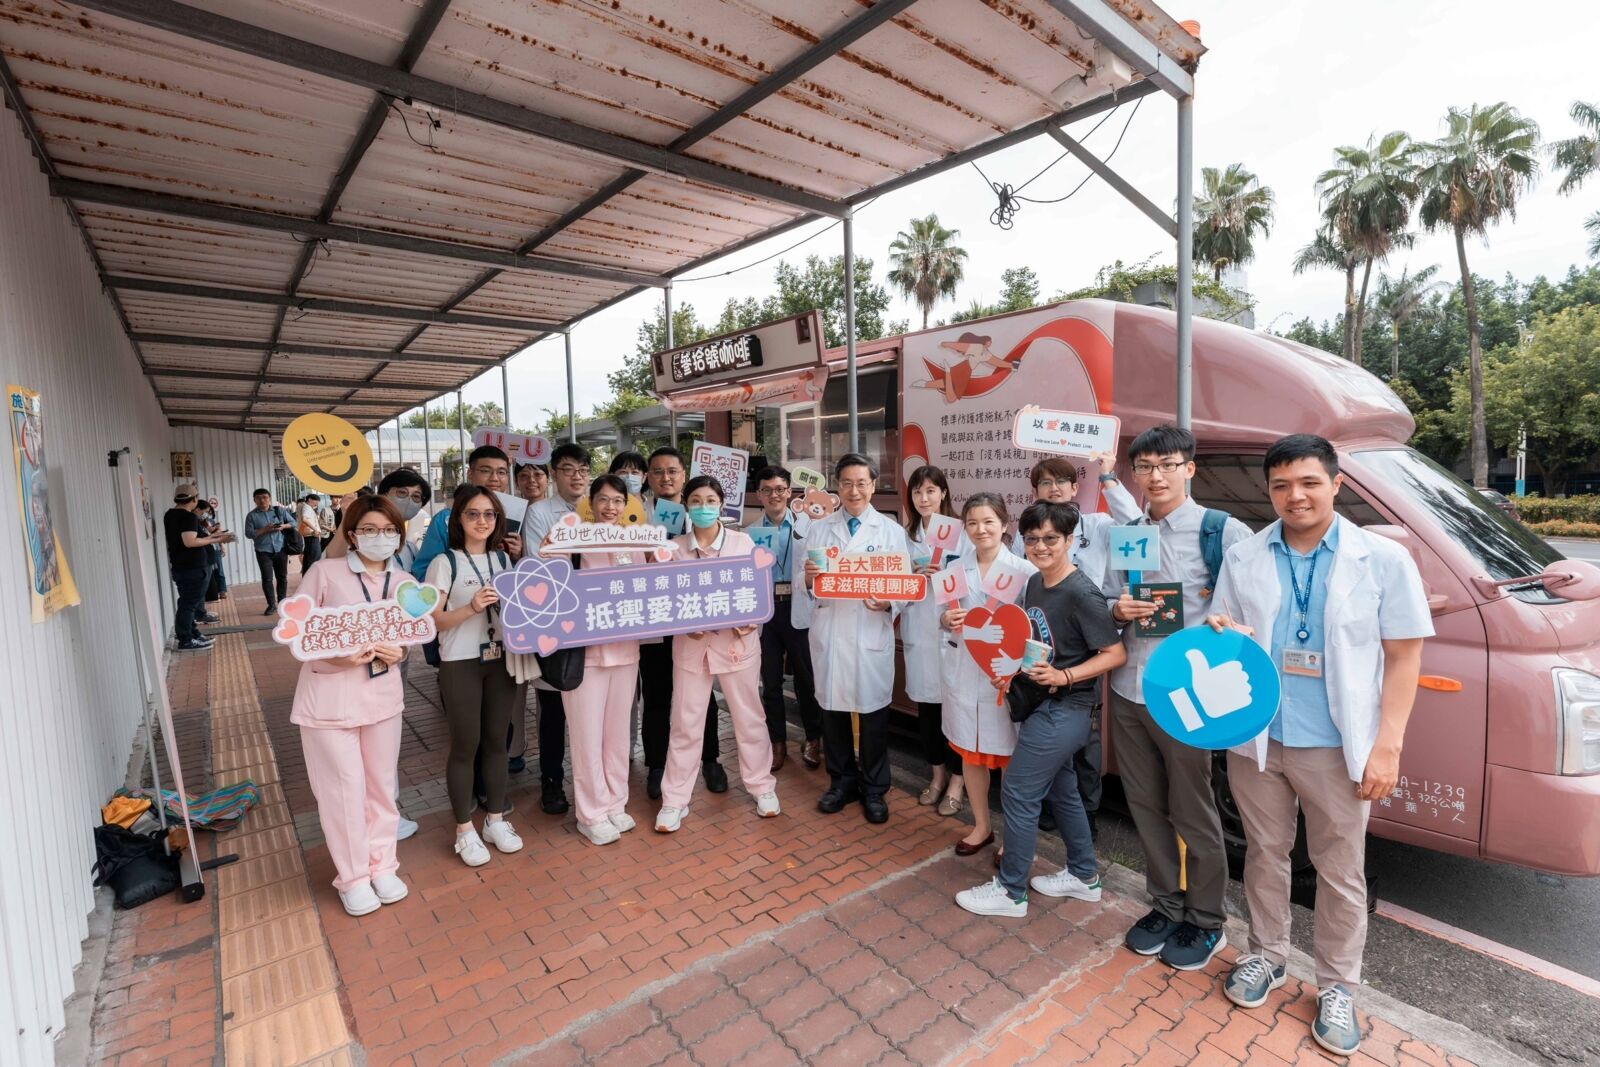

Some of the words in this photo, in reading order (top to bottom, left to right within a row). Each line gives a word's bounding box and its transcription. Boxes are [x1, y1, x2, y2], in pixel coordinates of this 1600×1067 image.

[1032, 418, 1100, 436] 以愛為起點
[297, 434, 327, 450] U=U
[659, 511, 680, 526] +1
[629, 528, 663, 542] Unite!
[754, 534, 772, 548] +1
[937, 524, 951, 541] U
[1118, 537, 1149, 559] +1
[837, 555, 903, 574] 台大醫院
[585, 566, 755, 596] 一般醫療防護就能
[820, 575, 921, 596] 愛滋照護團隊
[943, 575, 956, 594] U
[995, 573, 1013, 591] U
[585, 586, 758, 632] 抵禦愛滋病毒
[305, 606, 402, 634] 建立友善環境
